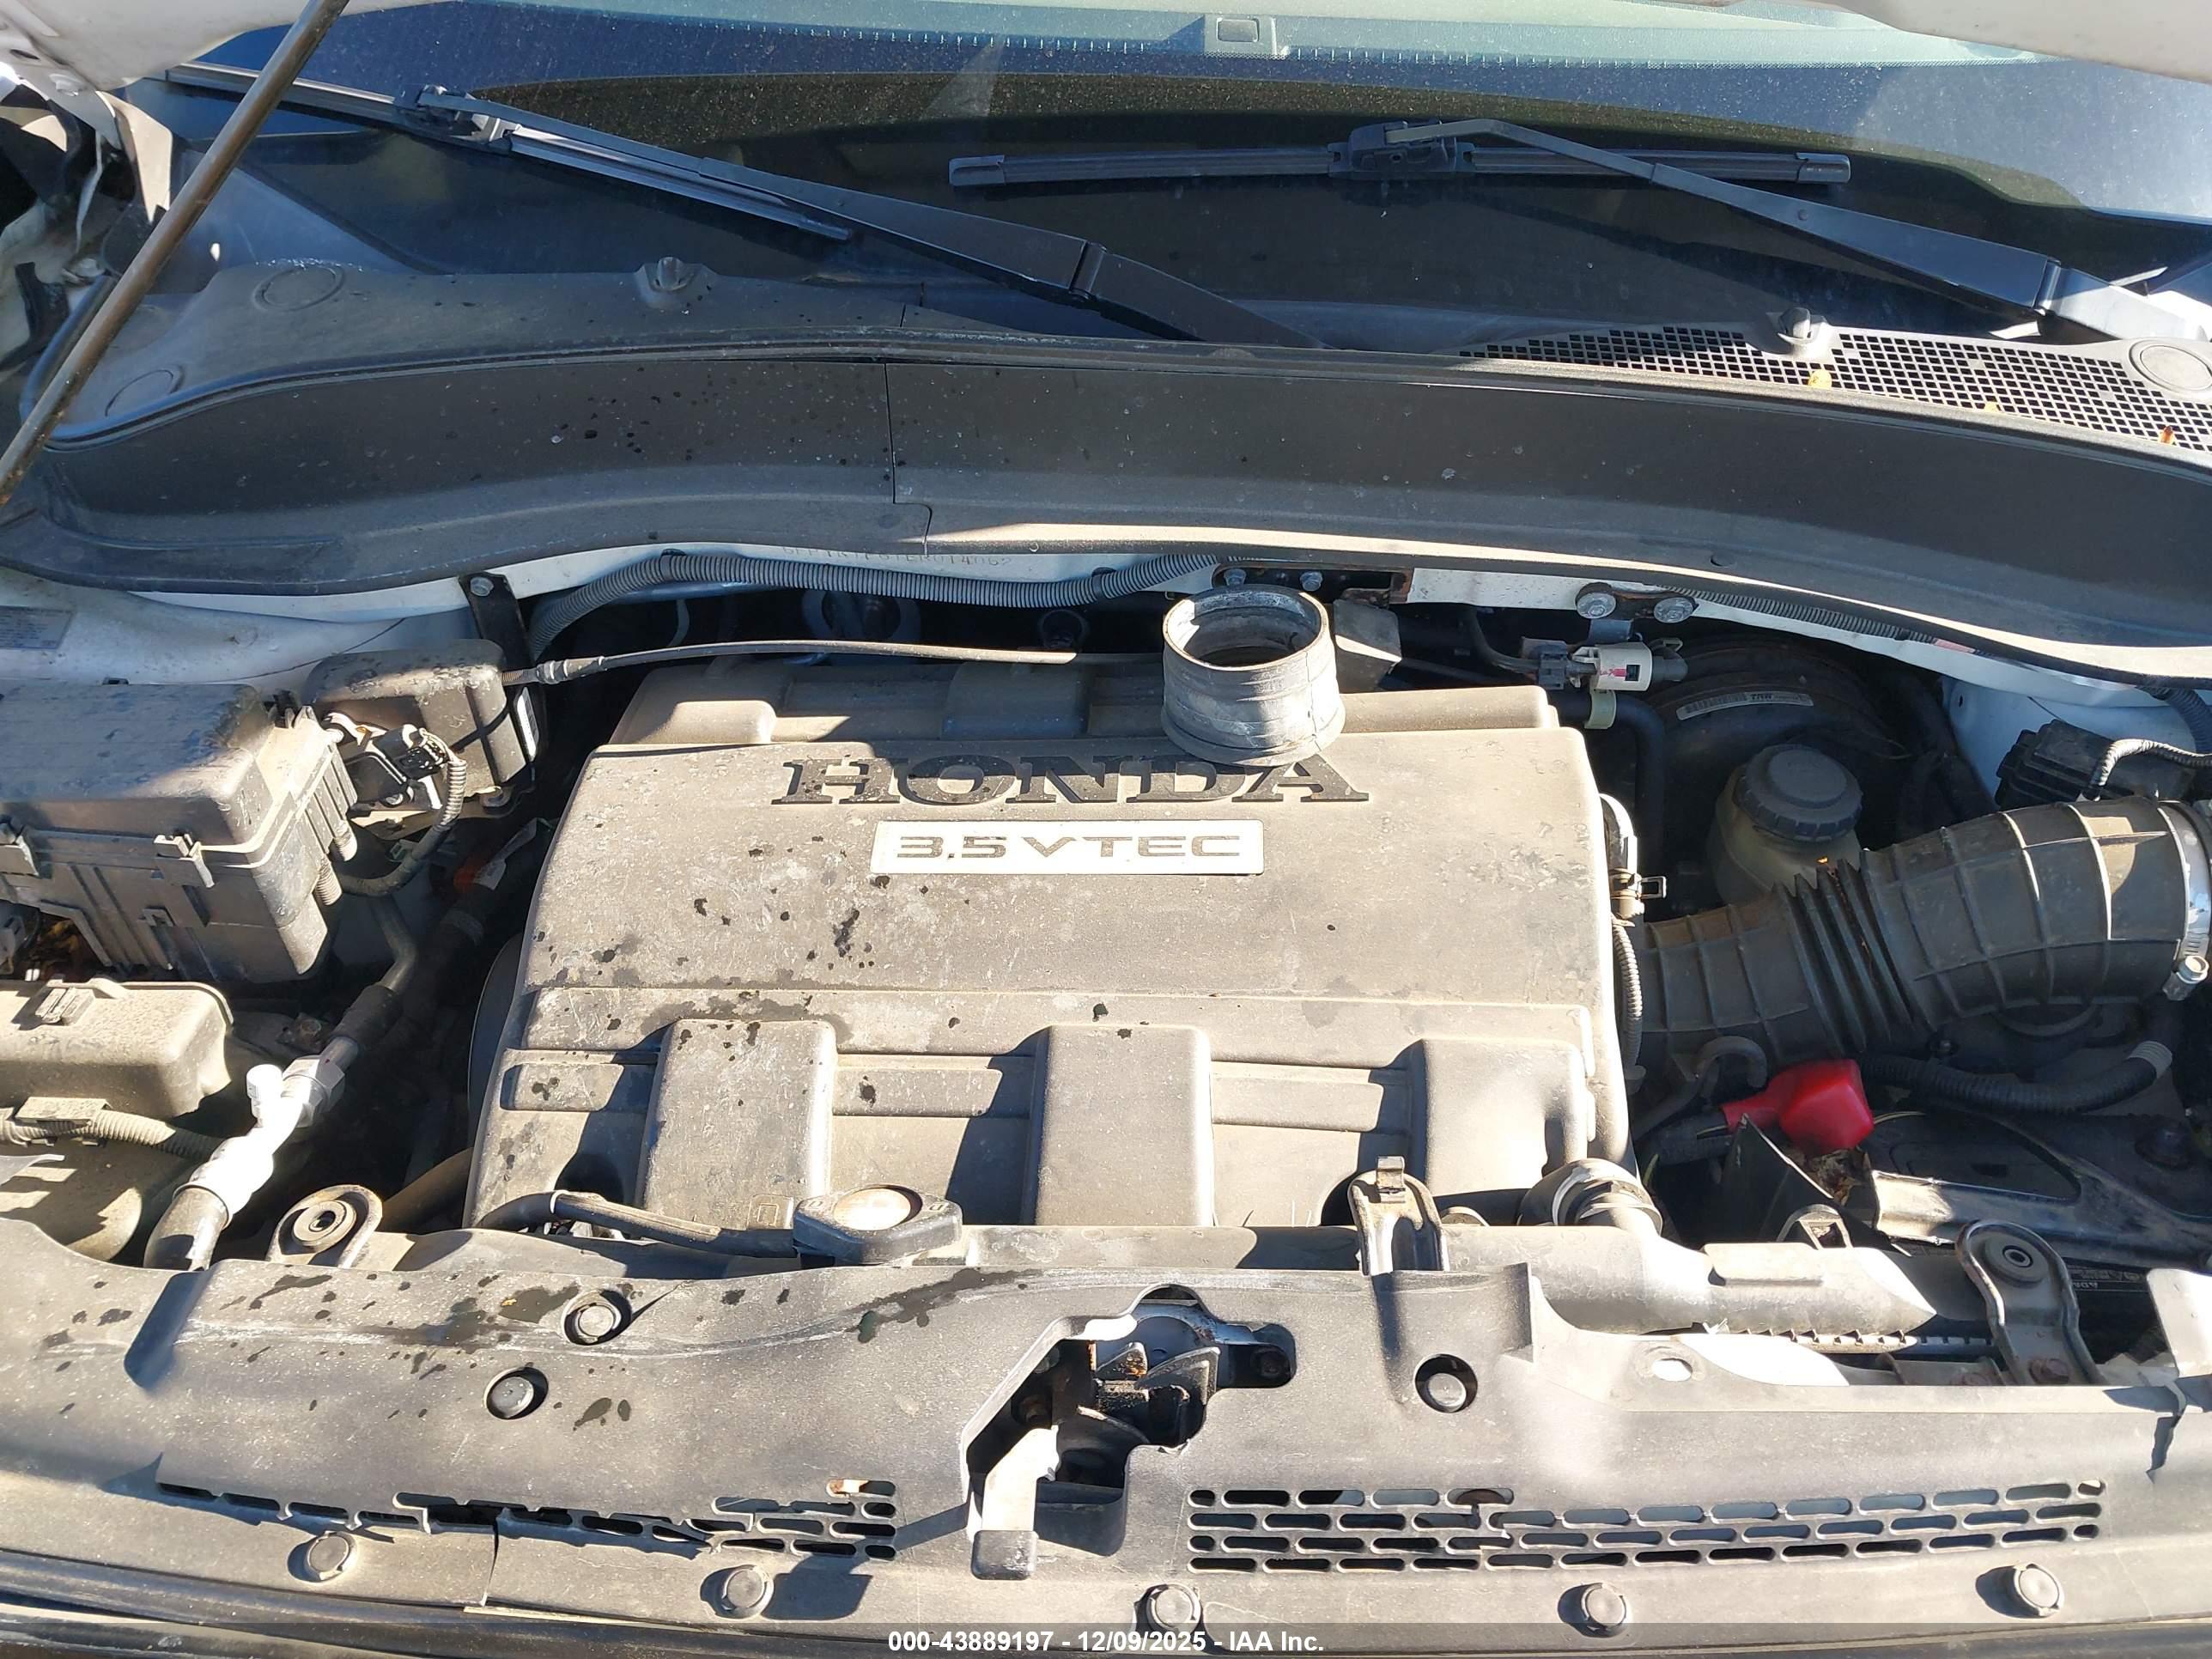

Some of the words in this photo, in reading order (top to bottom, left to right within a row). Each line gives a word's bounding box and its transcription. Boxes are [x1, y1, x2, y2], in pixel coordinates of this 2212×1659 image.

[770, 754, 1370, 804] HONDA
[896, 836, 1006, 859] 3.5
[1021, 836, 1240, 858] VTEC
